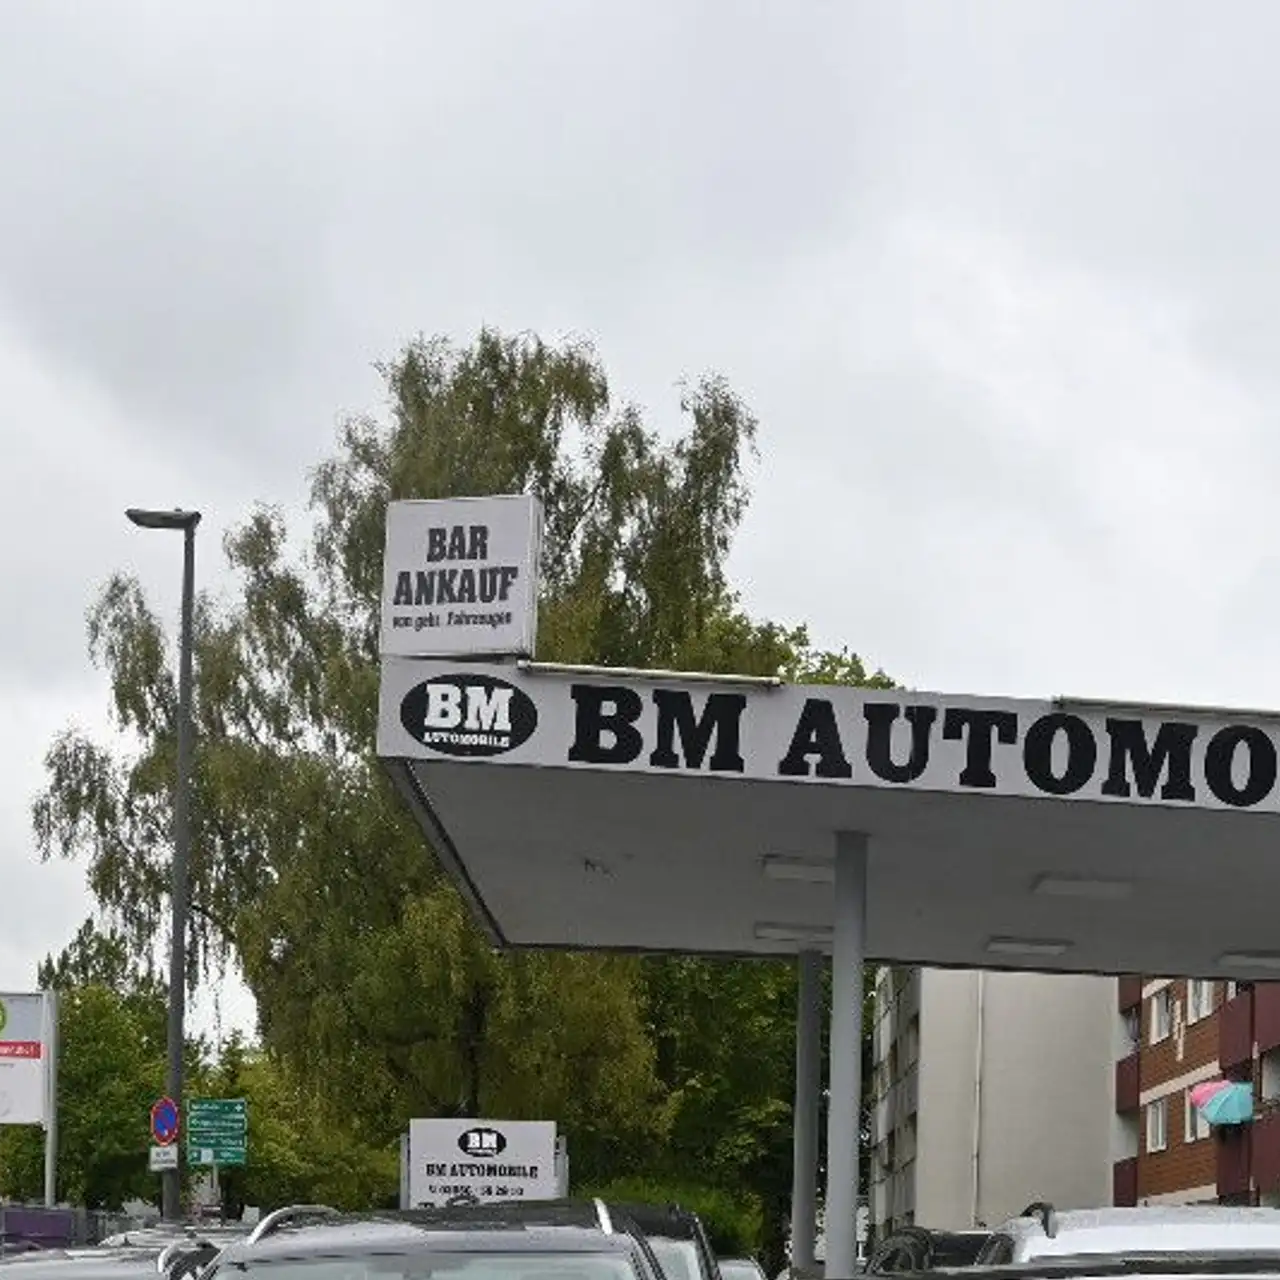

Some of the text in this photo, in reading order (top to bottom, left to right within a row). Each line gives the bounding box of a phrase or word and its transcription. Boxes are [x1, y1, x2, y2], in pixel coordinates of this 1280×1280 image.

[427, 526, 488, 562] BAR
[393, 567, 518, 605] ANKAUF
[423, 684, 514, 731] BM
[423, 732, 510, 747] AUTOMOBILE
[568, 685, 747, 773] BM
[467, 1133, 497, 1149] BM
[426, 1164, 538, 1178] BM AUTOMOBILE
